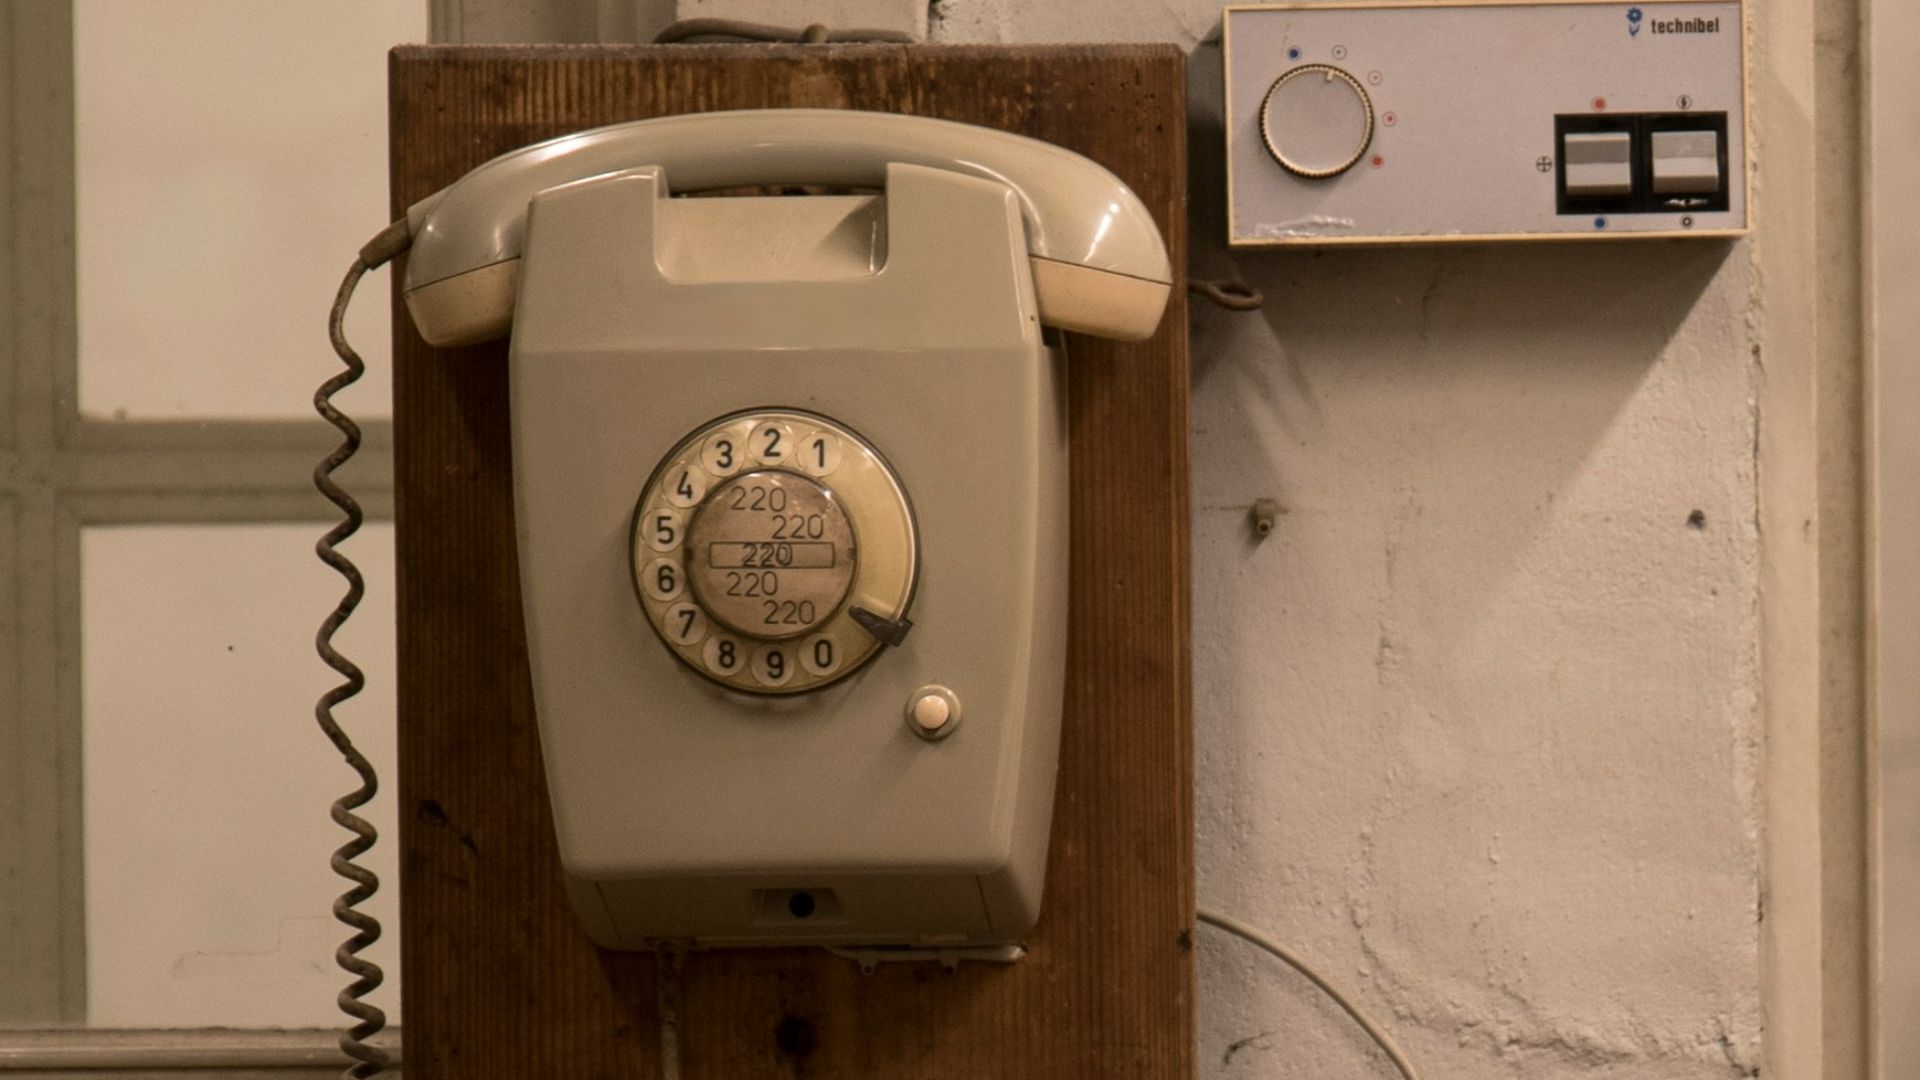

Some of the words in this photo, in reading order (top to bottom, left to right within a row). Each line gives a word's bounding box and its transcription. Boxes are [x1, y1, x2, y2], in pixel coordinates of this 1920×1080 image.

[1651, 17, 1720, 34] technibel
[715, 440, 733, 469] 3
[763, 428, 781, 457] 2
[812, 439, 825, 468] 1
[677, 471, 692, 499] 4
[731, 485, 786, 512] 220
[656, 515, 674, 545] 5
[771, 514, 824, 540] 220
[658, 566, 675, 593] 6
[726, 571, 778, 596] 220
[678, 610, 696, 639] 7
[763, 600, 815, 625] 220
[718, 640, 736, 669] 8
[766, 650, 784, 679] 9
[814, 638, 832, 667] 0
